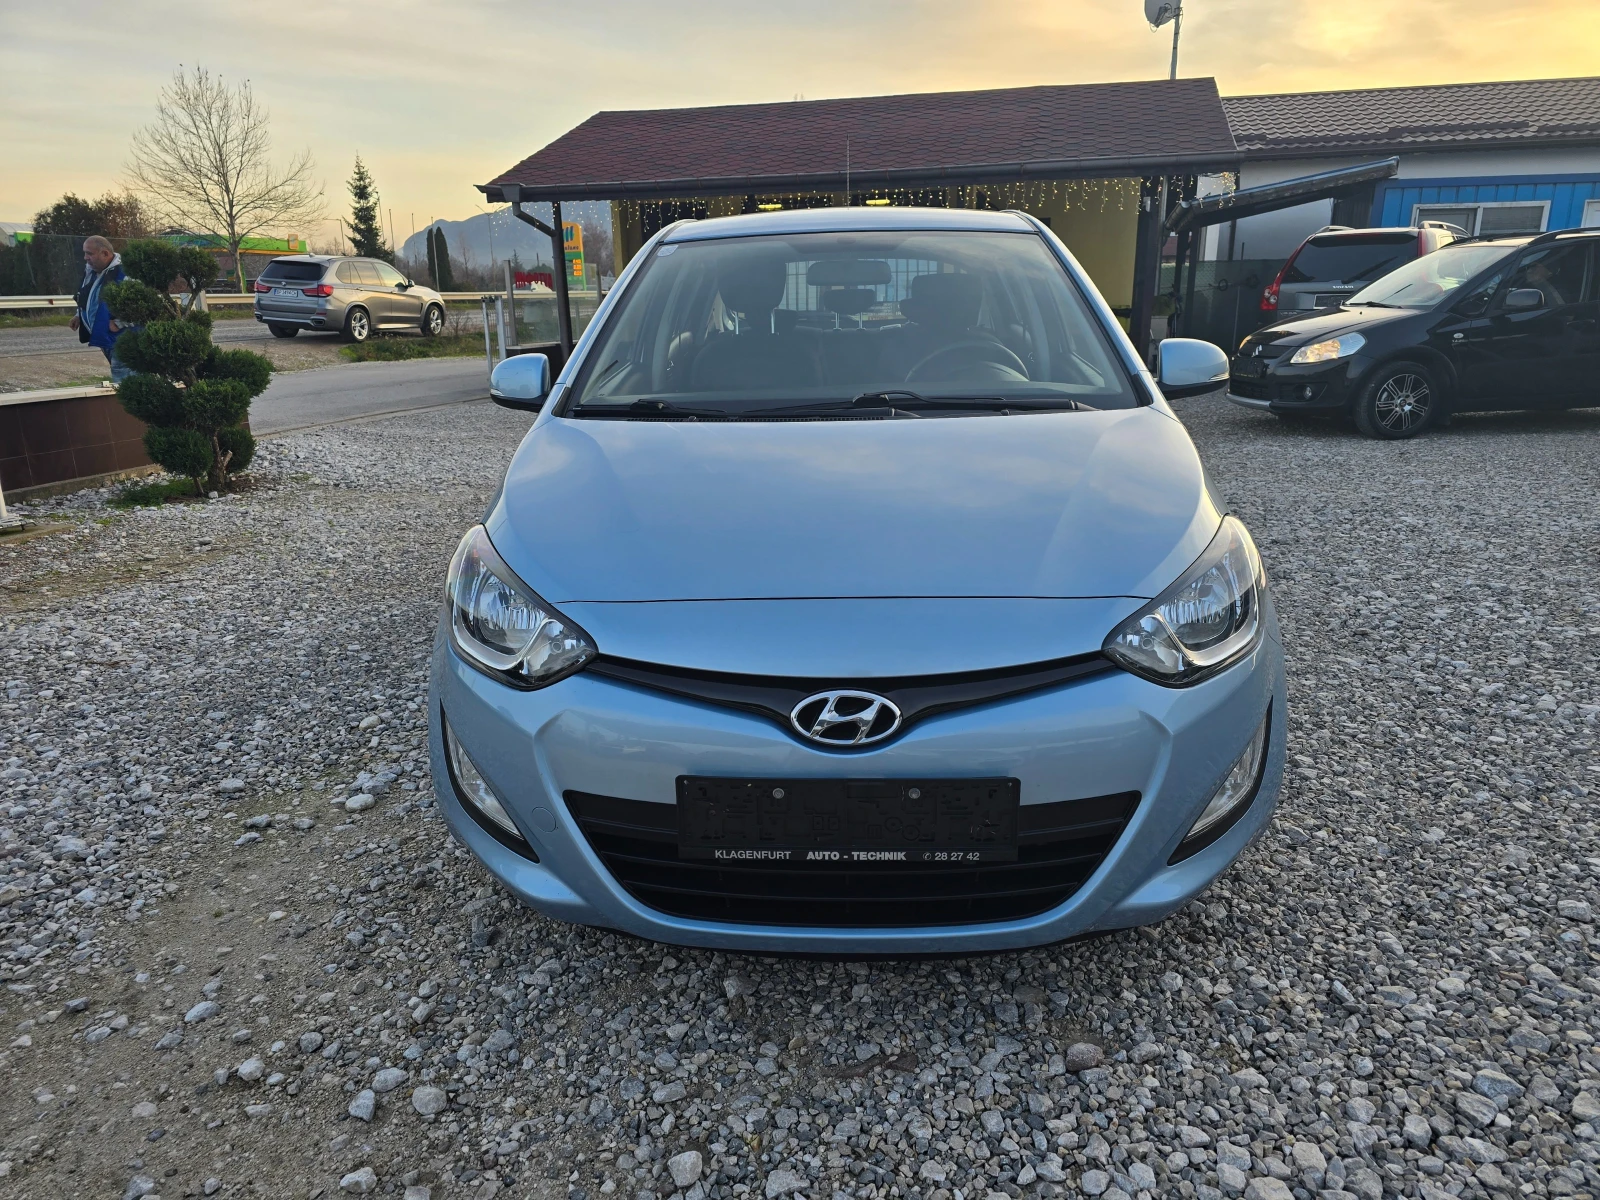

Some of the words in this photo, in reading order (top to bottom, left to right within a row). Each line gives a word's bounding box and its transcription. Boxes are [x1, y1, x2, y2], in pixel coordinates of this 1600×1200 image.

[715, 849, 791, 860] KLAGENFURT
[806, 851, 840, 861] AUTO
[851, 851, 907, 861] TECHNIK
[934, 852, 948, 861] 28
[951, 852, 964, 861] 27
[966, 852, 980, 861] 42
